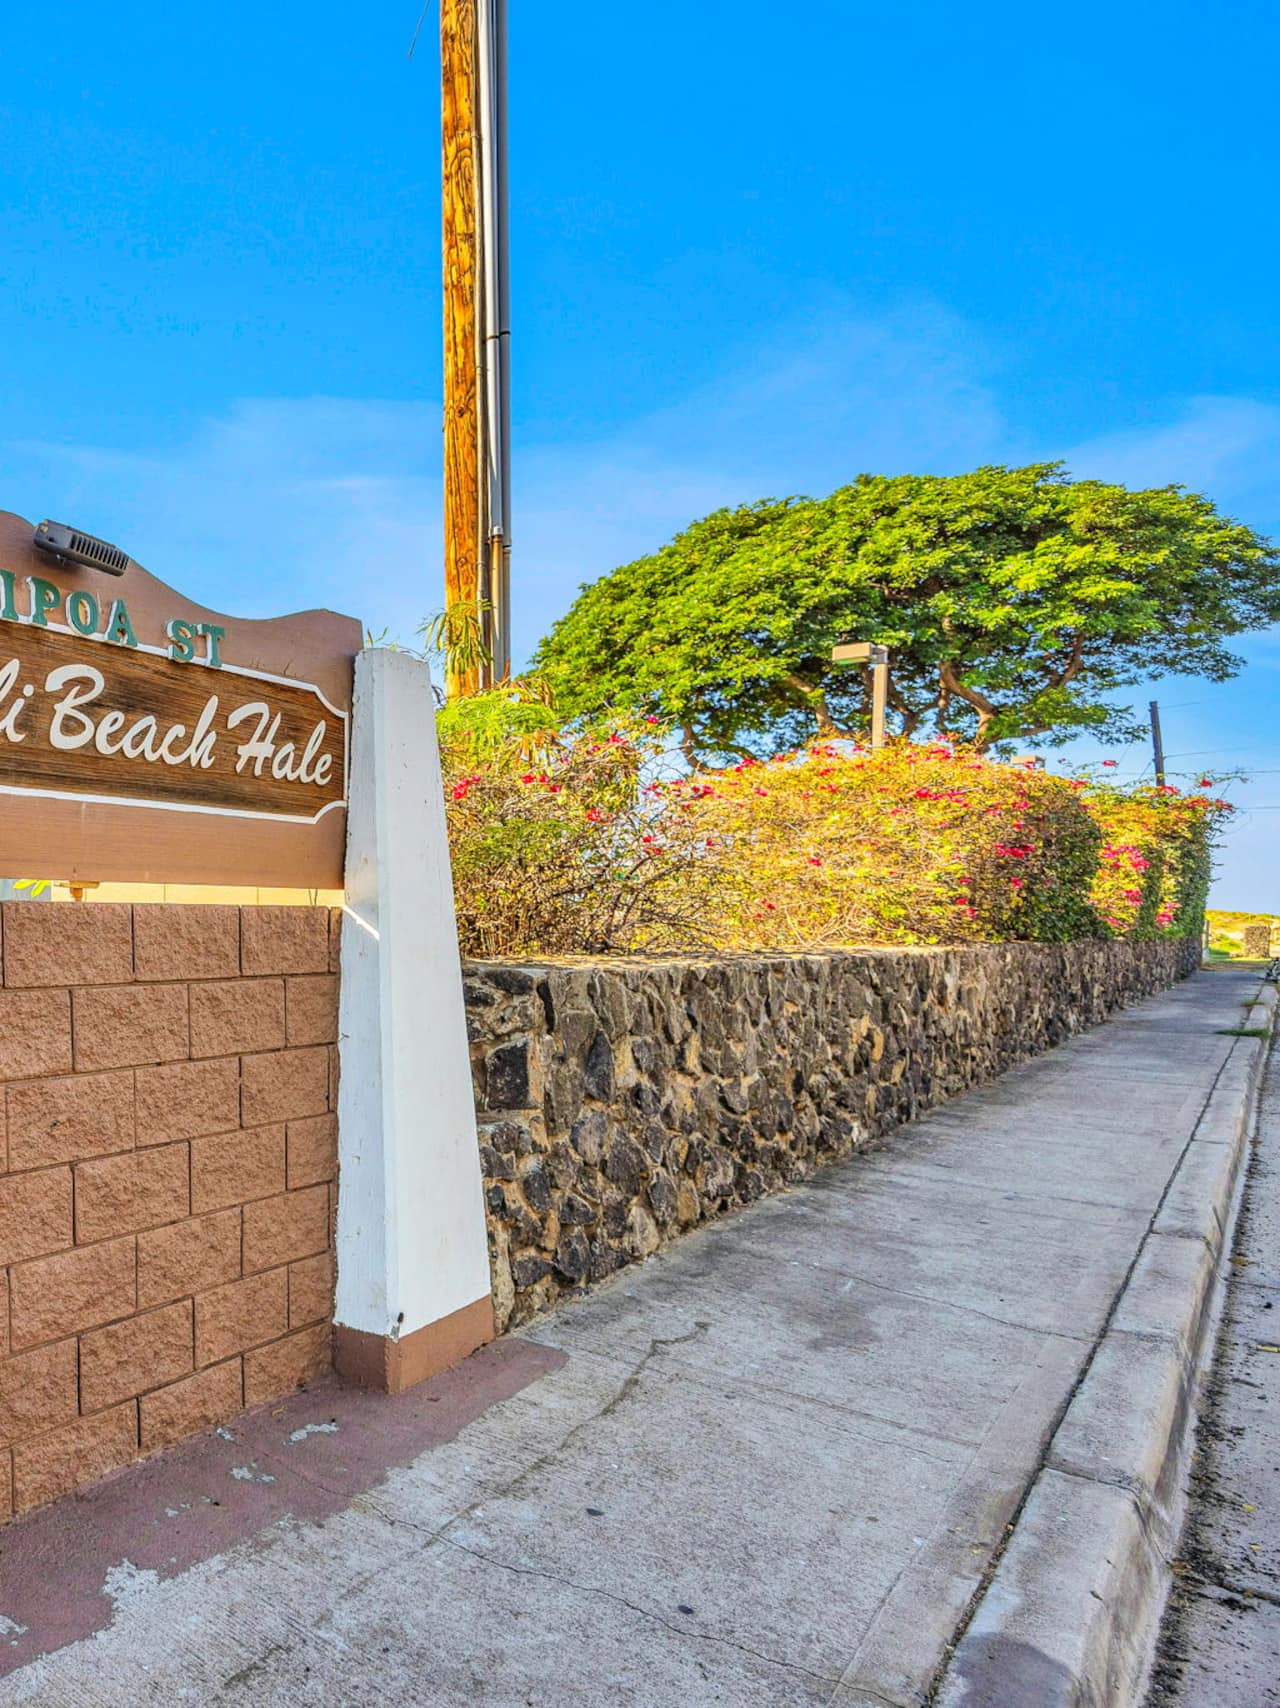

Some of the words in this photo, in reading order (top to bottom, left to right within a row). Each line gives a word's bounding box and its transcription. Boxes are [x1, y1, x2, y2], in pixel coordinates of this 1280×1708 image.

[166, 618, 226, 668] ST
[45, 663, 218, 769] Beach
[227, 702, 333, 786] Hale
